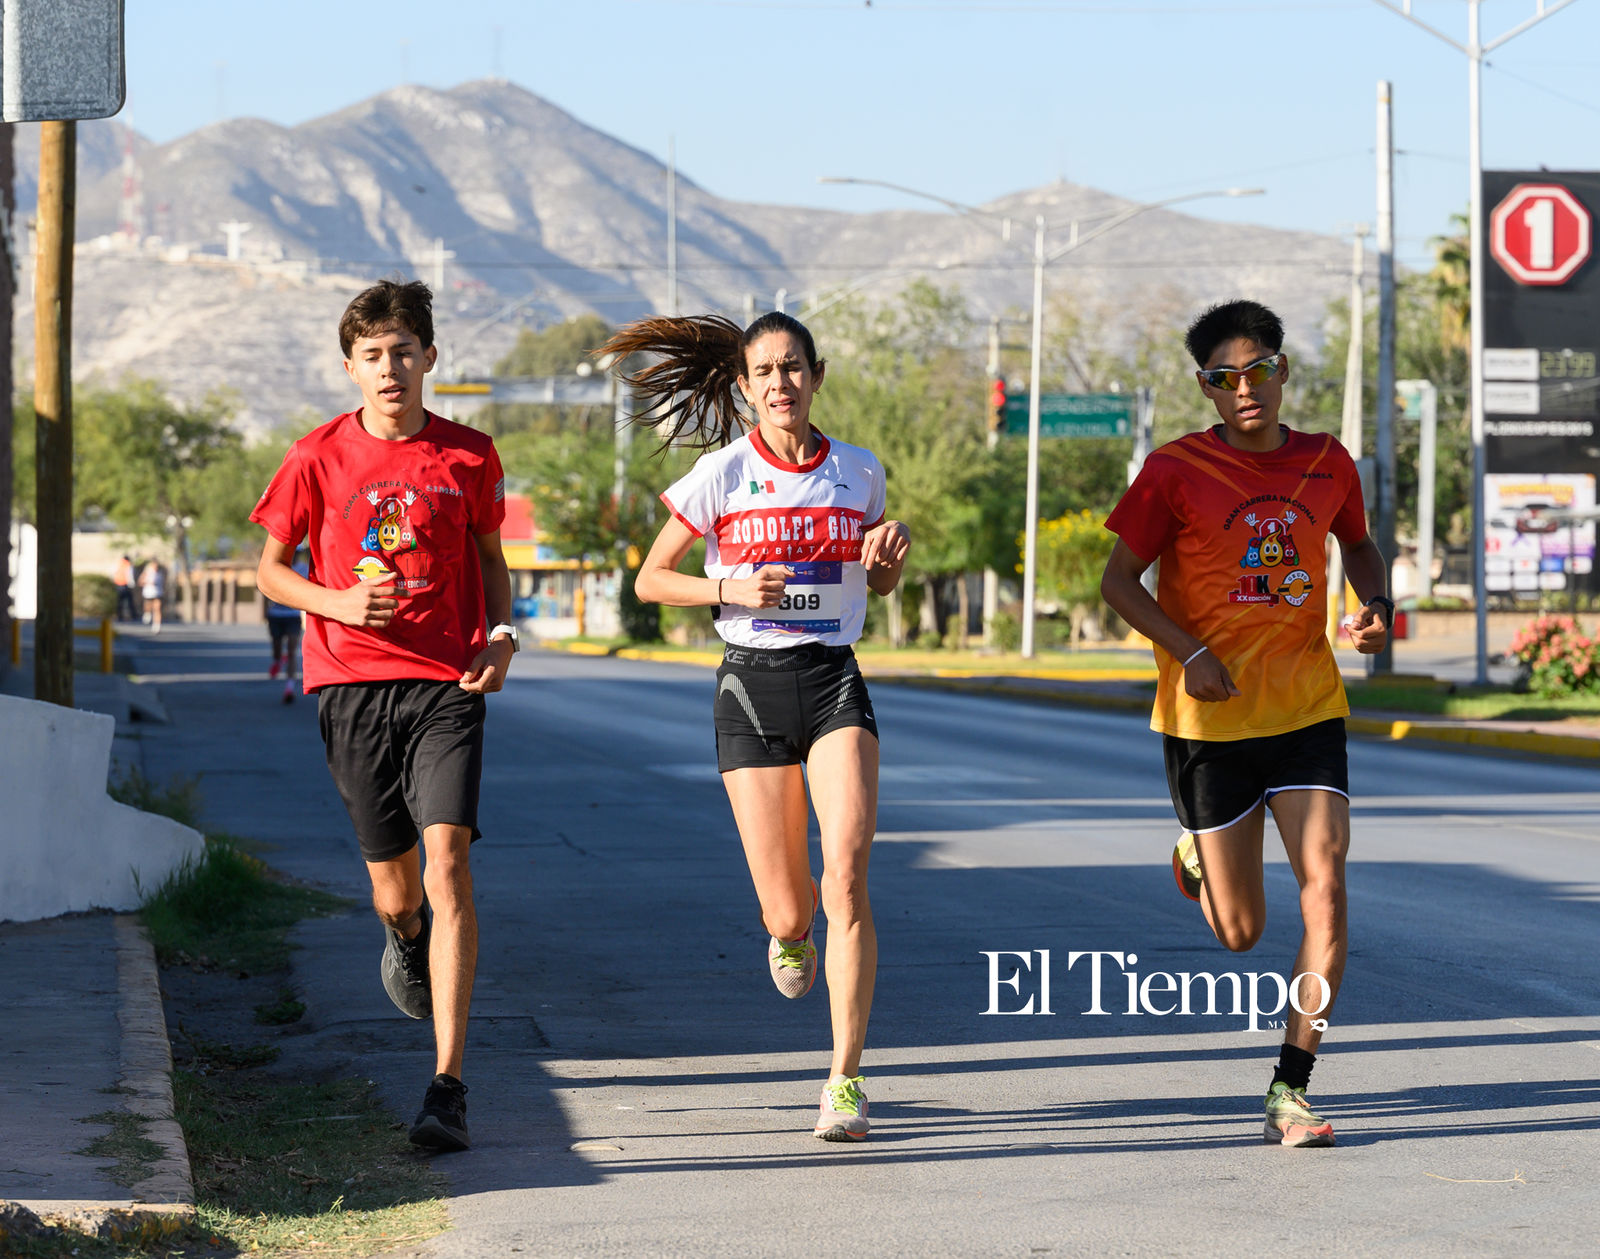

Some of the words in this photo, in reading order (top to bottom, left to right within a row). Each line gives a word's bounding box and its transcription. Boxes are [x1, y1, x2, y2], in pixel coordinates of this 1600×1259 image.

[1524, 199, 1555, 269] 1
[1301, 472, 1334, 480] SIMSA
[343, 493, 360, 520] GRAN
[359, 480, 402, 495] CARRERA
[404, 481, 438, 521] NACIONAL
[425, 485, 464, 497] SIMSA
[1223, 508, 1241, 531] GRAN
[1239, 494, 1278, 511] CARRERA
[1279, 495, 1318, 526] NACIONAL
[732, 516, 814, 544] RODOLFO
[741, 547, 782, 556] CLUB
[1237, 574, 1271, 594] 10K
